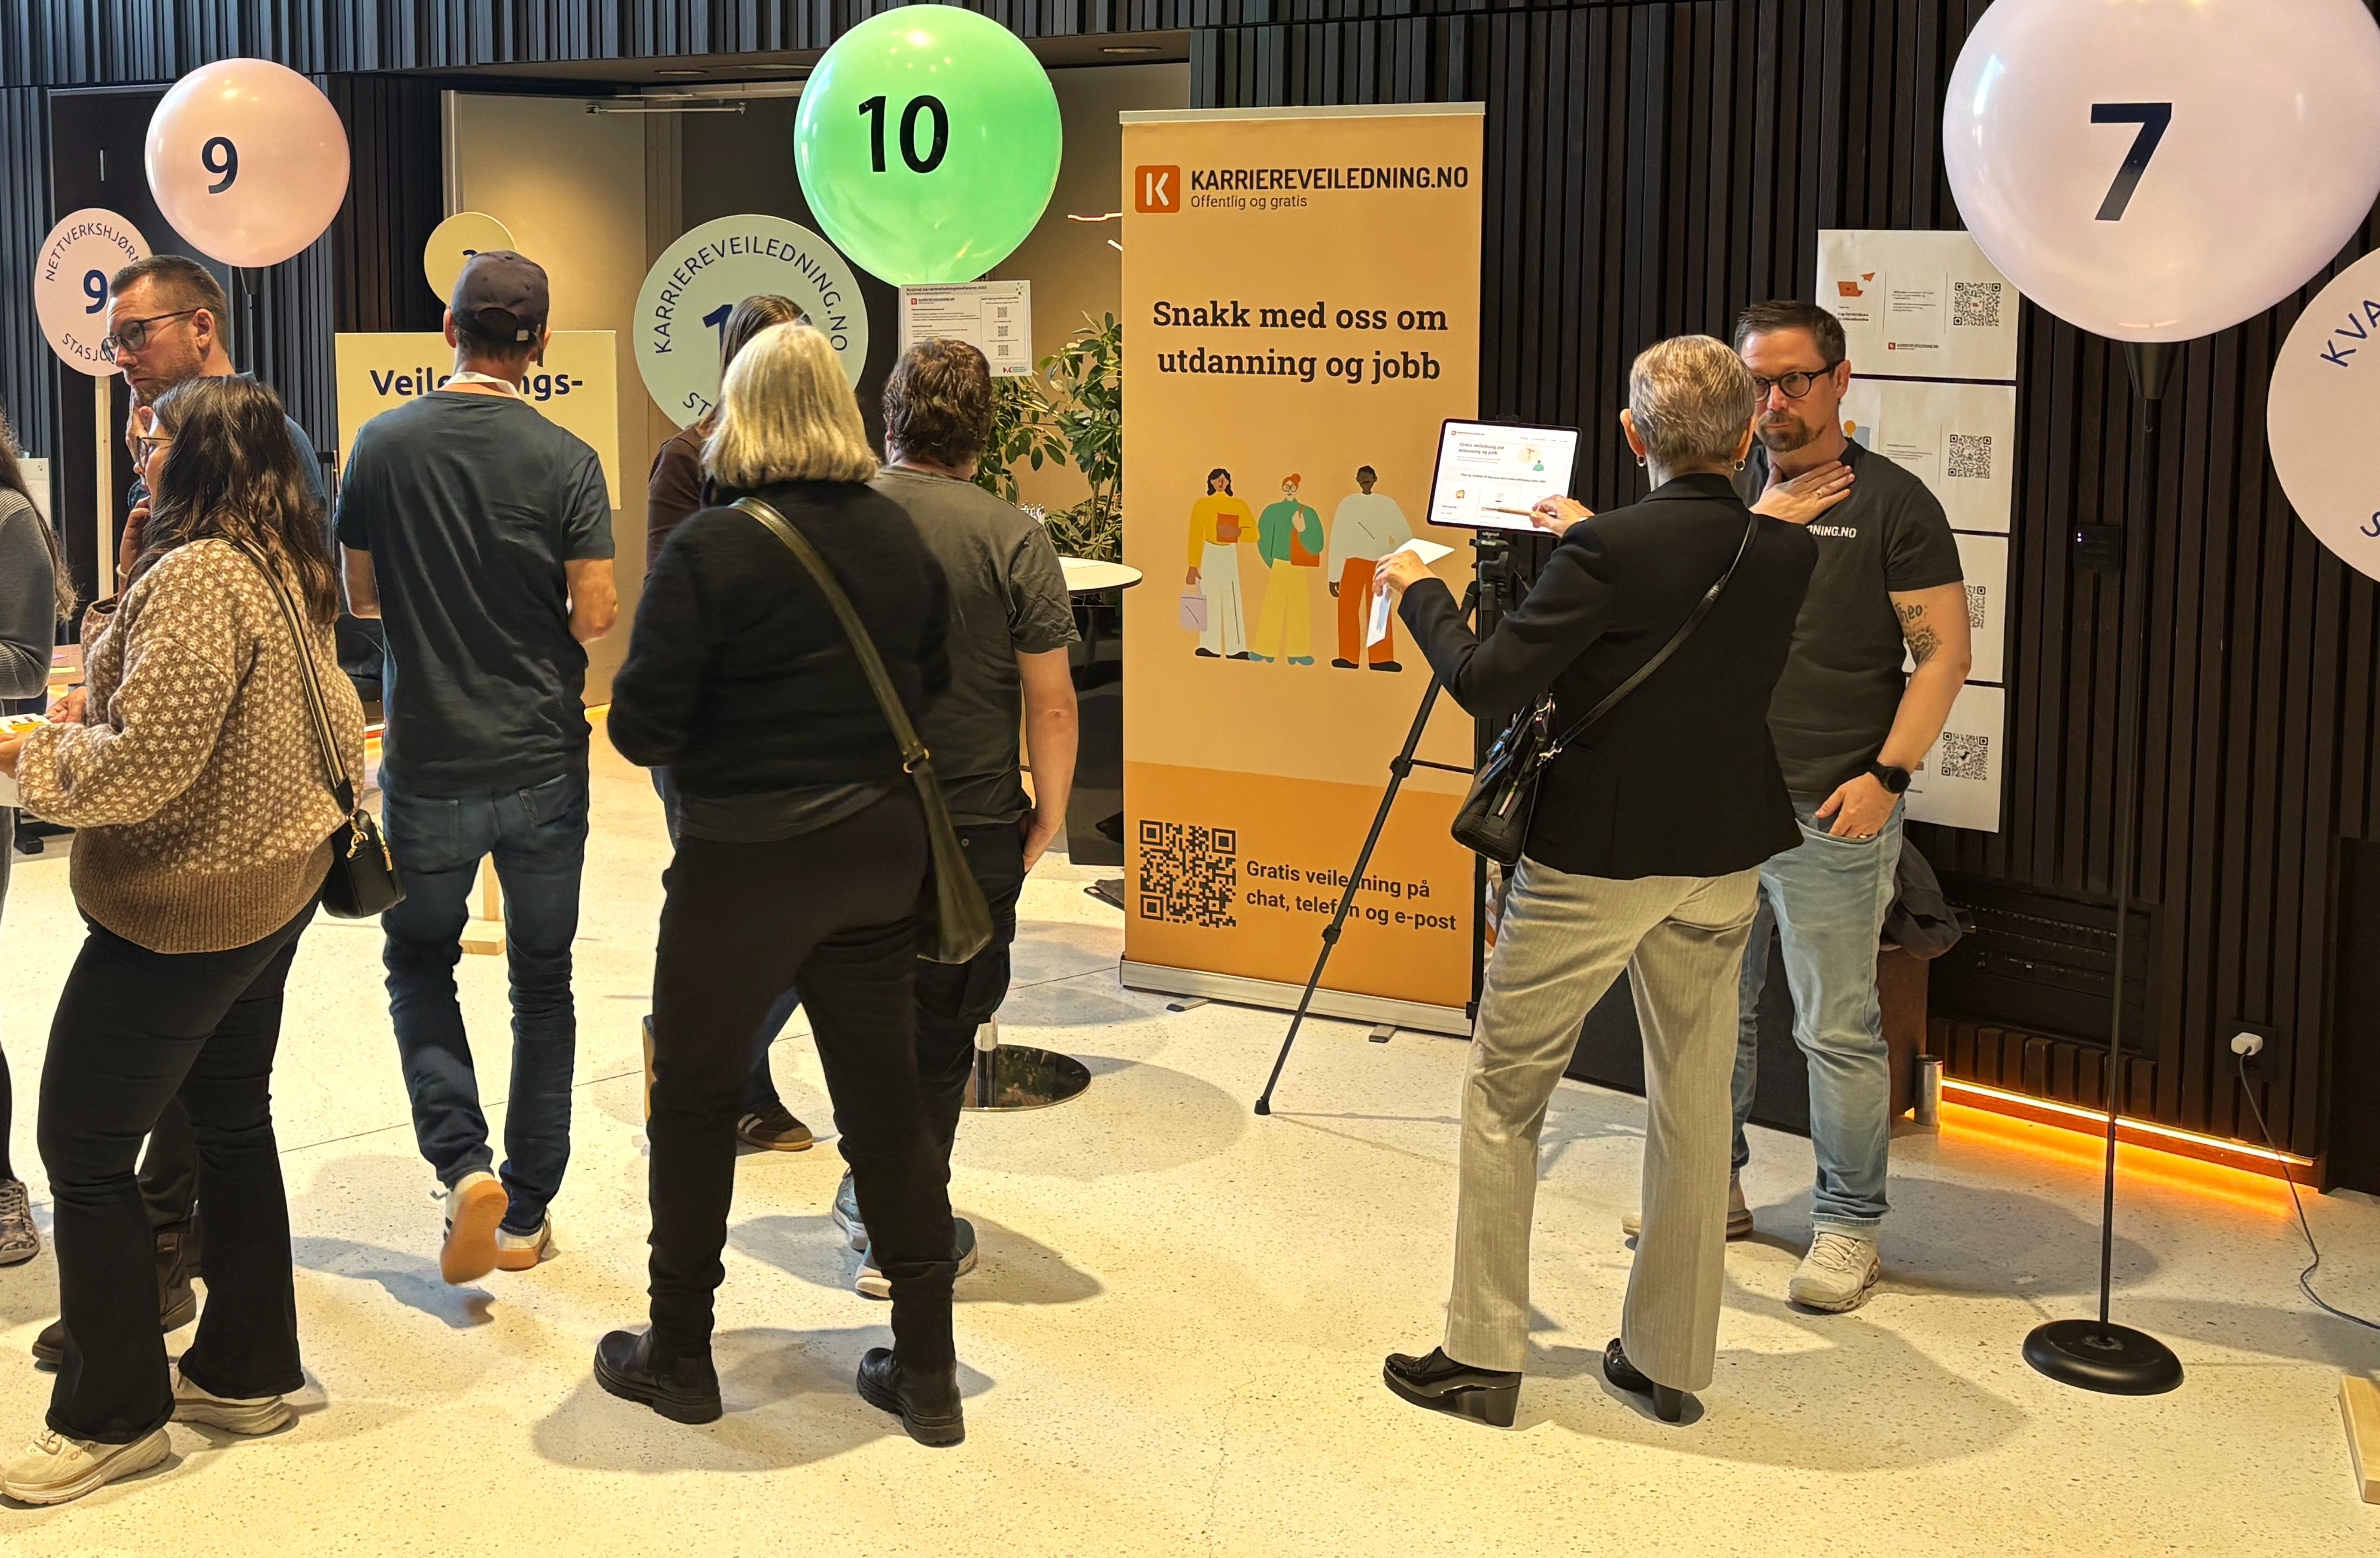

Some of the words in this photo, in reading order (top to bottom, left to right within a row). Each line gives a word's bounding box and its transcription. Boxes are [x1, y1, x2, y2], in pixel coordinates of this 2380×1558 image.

[859, 95, 949, 173] 10
[201, 137, 238, 194] 9
[1191, 166, 1468, 191] KARRIEREVEILEDNING.NO
[2091, 102, 2173, 222] 7
[1191, 194, 1246, 211] Offentlig
[1249, 198, 1267, 210] og
[1270, 195, 1308, 210] gratis
[83, 269, 108, 314] 9
[654, 235, 848, 354] KARRIEREVEILEDNING.NO
[1153, 300, 1251, 327] Snakk
[1259, 301, 1327, 328] med
[1336, 309, 1387, 329] oss
[1397, 310, 1449, 331] om
[1157, 347, 1318, 383] utdanning
[1326, 357, 1365, 384] og
[1371, 350, 1440, 385] jobb
[1246, 860, 1300, 882] Gratis
[1305, 869, 1401, 898] veilening
[1407, 879, 1430, 900] på
[1246, 888, 1290, 912] chat,
[1296, 895, 1360, 918] telefn
[1365, 908, 1389, 926] og
[1394, 911, 1457, 930] e-post
